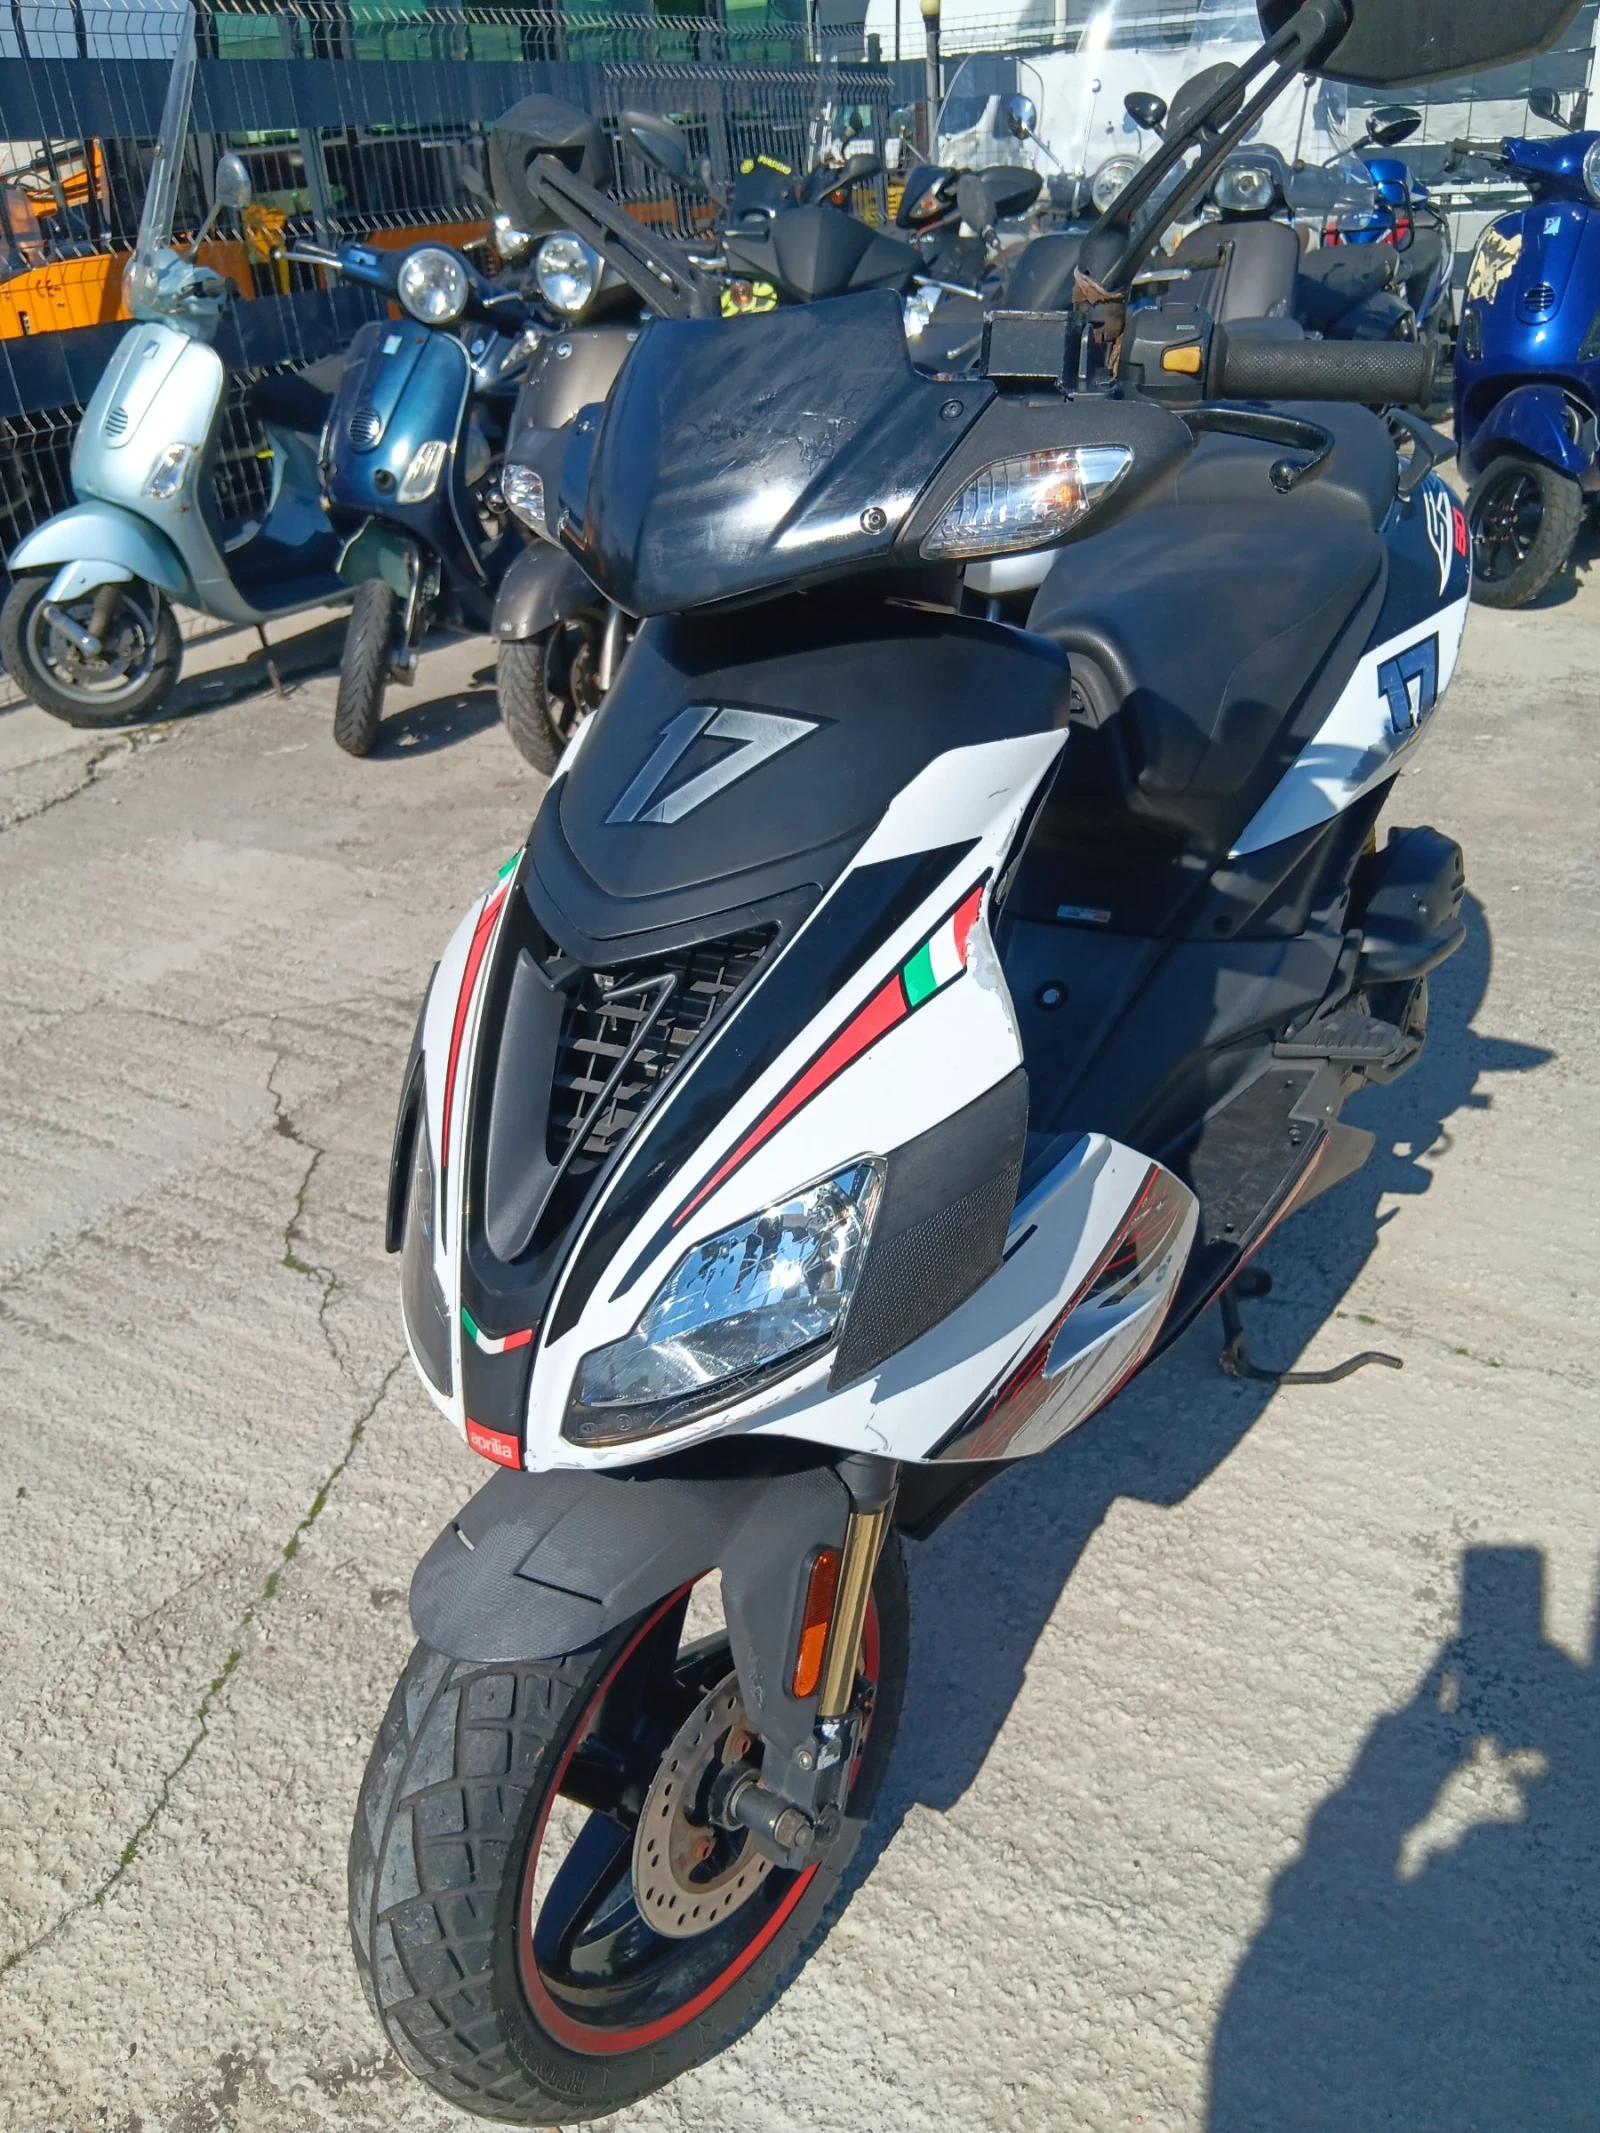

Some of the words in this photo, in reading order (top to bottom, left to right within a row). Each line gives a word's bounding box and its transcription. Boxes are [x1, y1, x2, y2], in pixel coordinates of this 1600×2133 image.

[1377, 630, 1439, 734] 17
[604, 702, 826, 825] 17
[470, 1431, 513, 1460] aprilia
